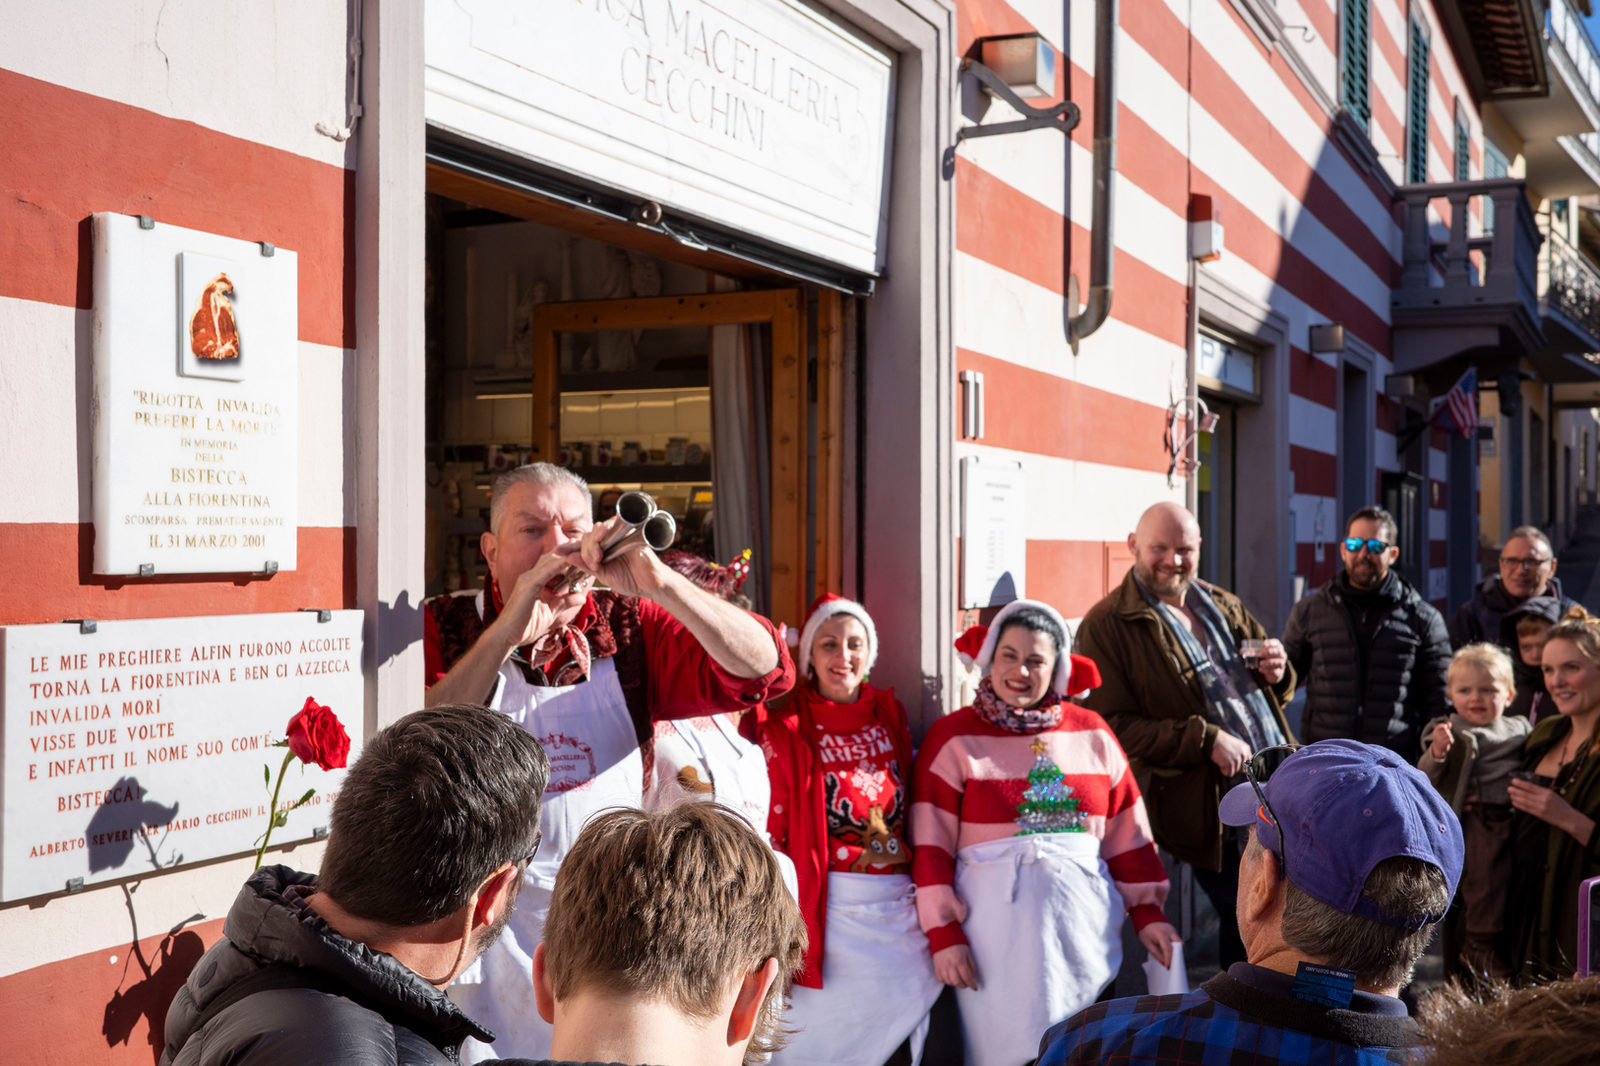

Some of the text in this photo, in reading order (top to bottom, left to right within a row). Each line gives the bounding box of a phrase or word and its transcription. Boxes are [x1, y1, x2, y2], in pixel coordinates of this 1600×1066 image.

[664, 0, 842, 134] MACELLERIA
[620, 46, 765, 152] CECCHINI
[206, 417, 224, 432] LA
[180, 437, 239, 450] IN MEMORIA
[194, 452, 225, 463] DELLA
[170, 467, 248, 486] BISTECCA
[143, 491, 271, 508] ALLA FIORENTINA
[124, 514, 285, 527] SCOMPARSA PREMATURAMENTE
[168, 533, 180, 548] 31
[185, 533, 237, 548] MARZO
[242, 533, 266, 548] 2001
[30, 637, 351, 673] LE MIE PREGHIERE ALFIN FURONO ACCOLTE
[29, 659, 350, 700] TORNA LA FIORENTINA E BEN CI AZZECCA
[29, 703, 112, 727] INVALIDA
[30, 722, 175, 753] VISSE DUE VOLTE
[29, 763, 38, 781] E
[48, 754, 115, 778] INFATTI
[124, 751, 137, 768] IL
[147, 744, 188, 765] NOME
[196, 739, 223, 758] SUO
[57, 783, 140, 813] BISTECCA!
[29, 837, 85, 859] ALBERTO
[92, 828, 134, 846] SEVERI
[140, 824, 159, 838] PER
[166, 816, 200, 833] DARIO
[205, 807, 252, 826] CECCHINI
[257, 805, 266, 816] IL
